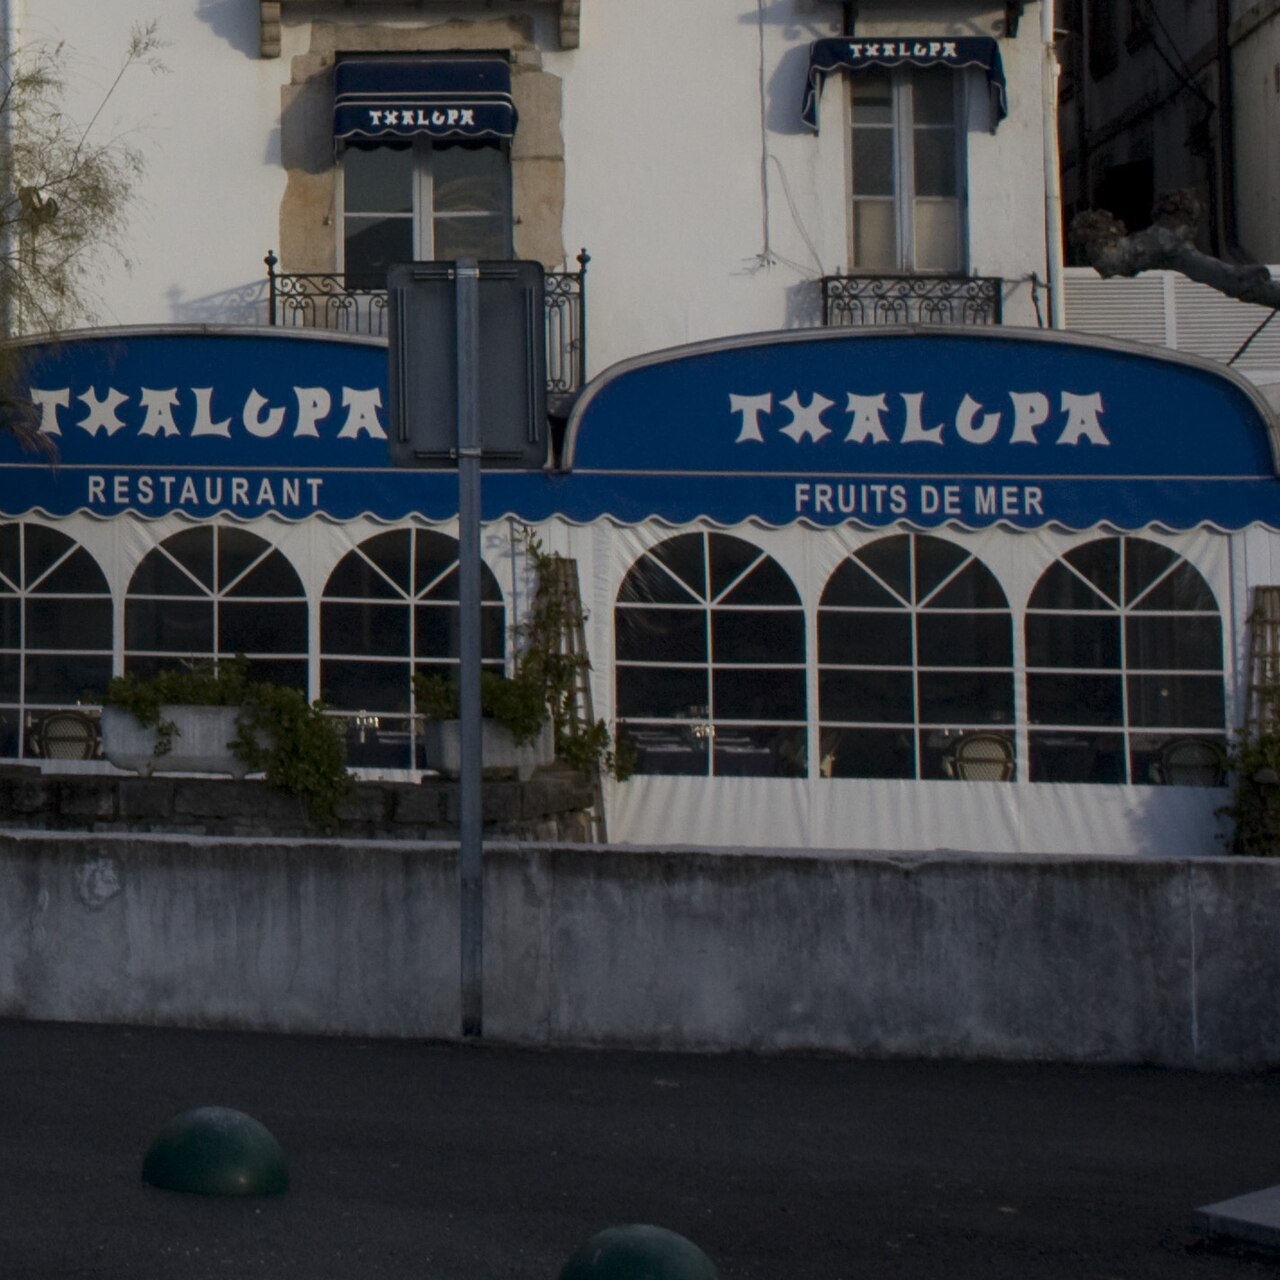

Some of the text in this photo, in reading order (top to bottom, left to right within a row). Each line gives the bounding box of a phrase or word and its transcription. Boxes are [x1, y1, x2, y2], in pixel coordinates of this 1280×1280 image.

[849, 42, 958, 58] TXALUPA
[368, 108, 476, 126] TXALUPA
[28, 384, 389, 440] TXALUPA
[728, 389, 1112, 446] TXALUPA
[88, 475, 325, 506] RESTAURANT
[795, 483, 1044, 516] FRUITS DE MER
